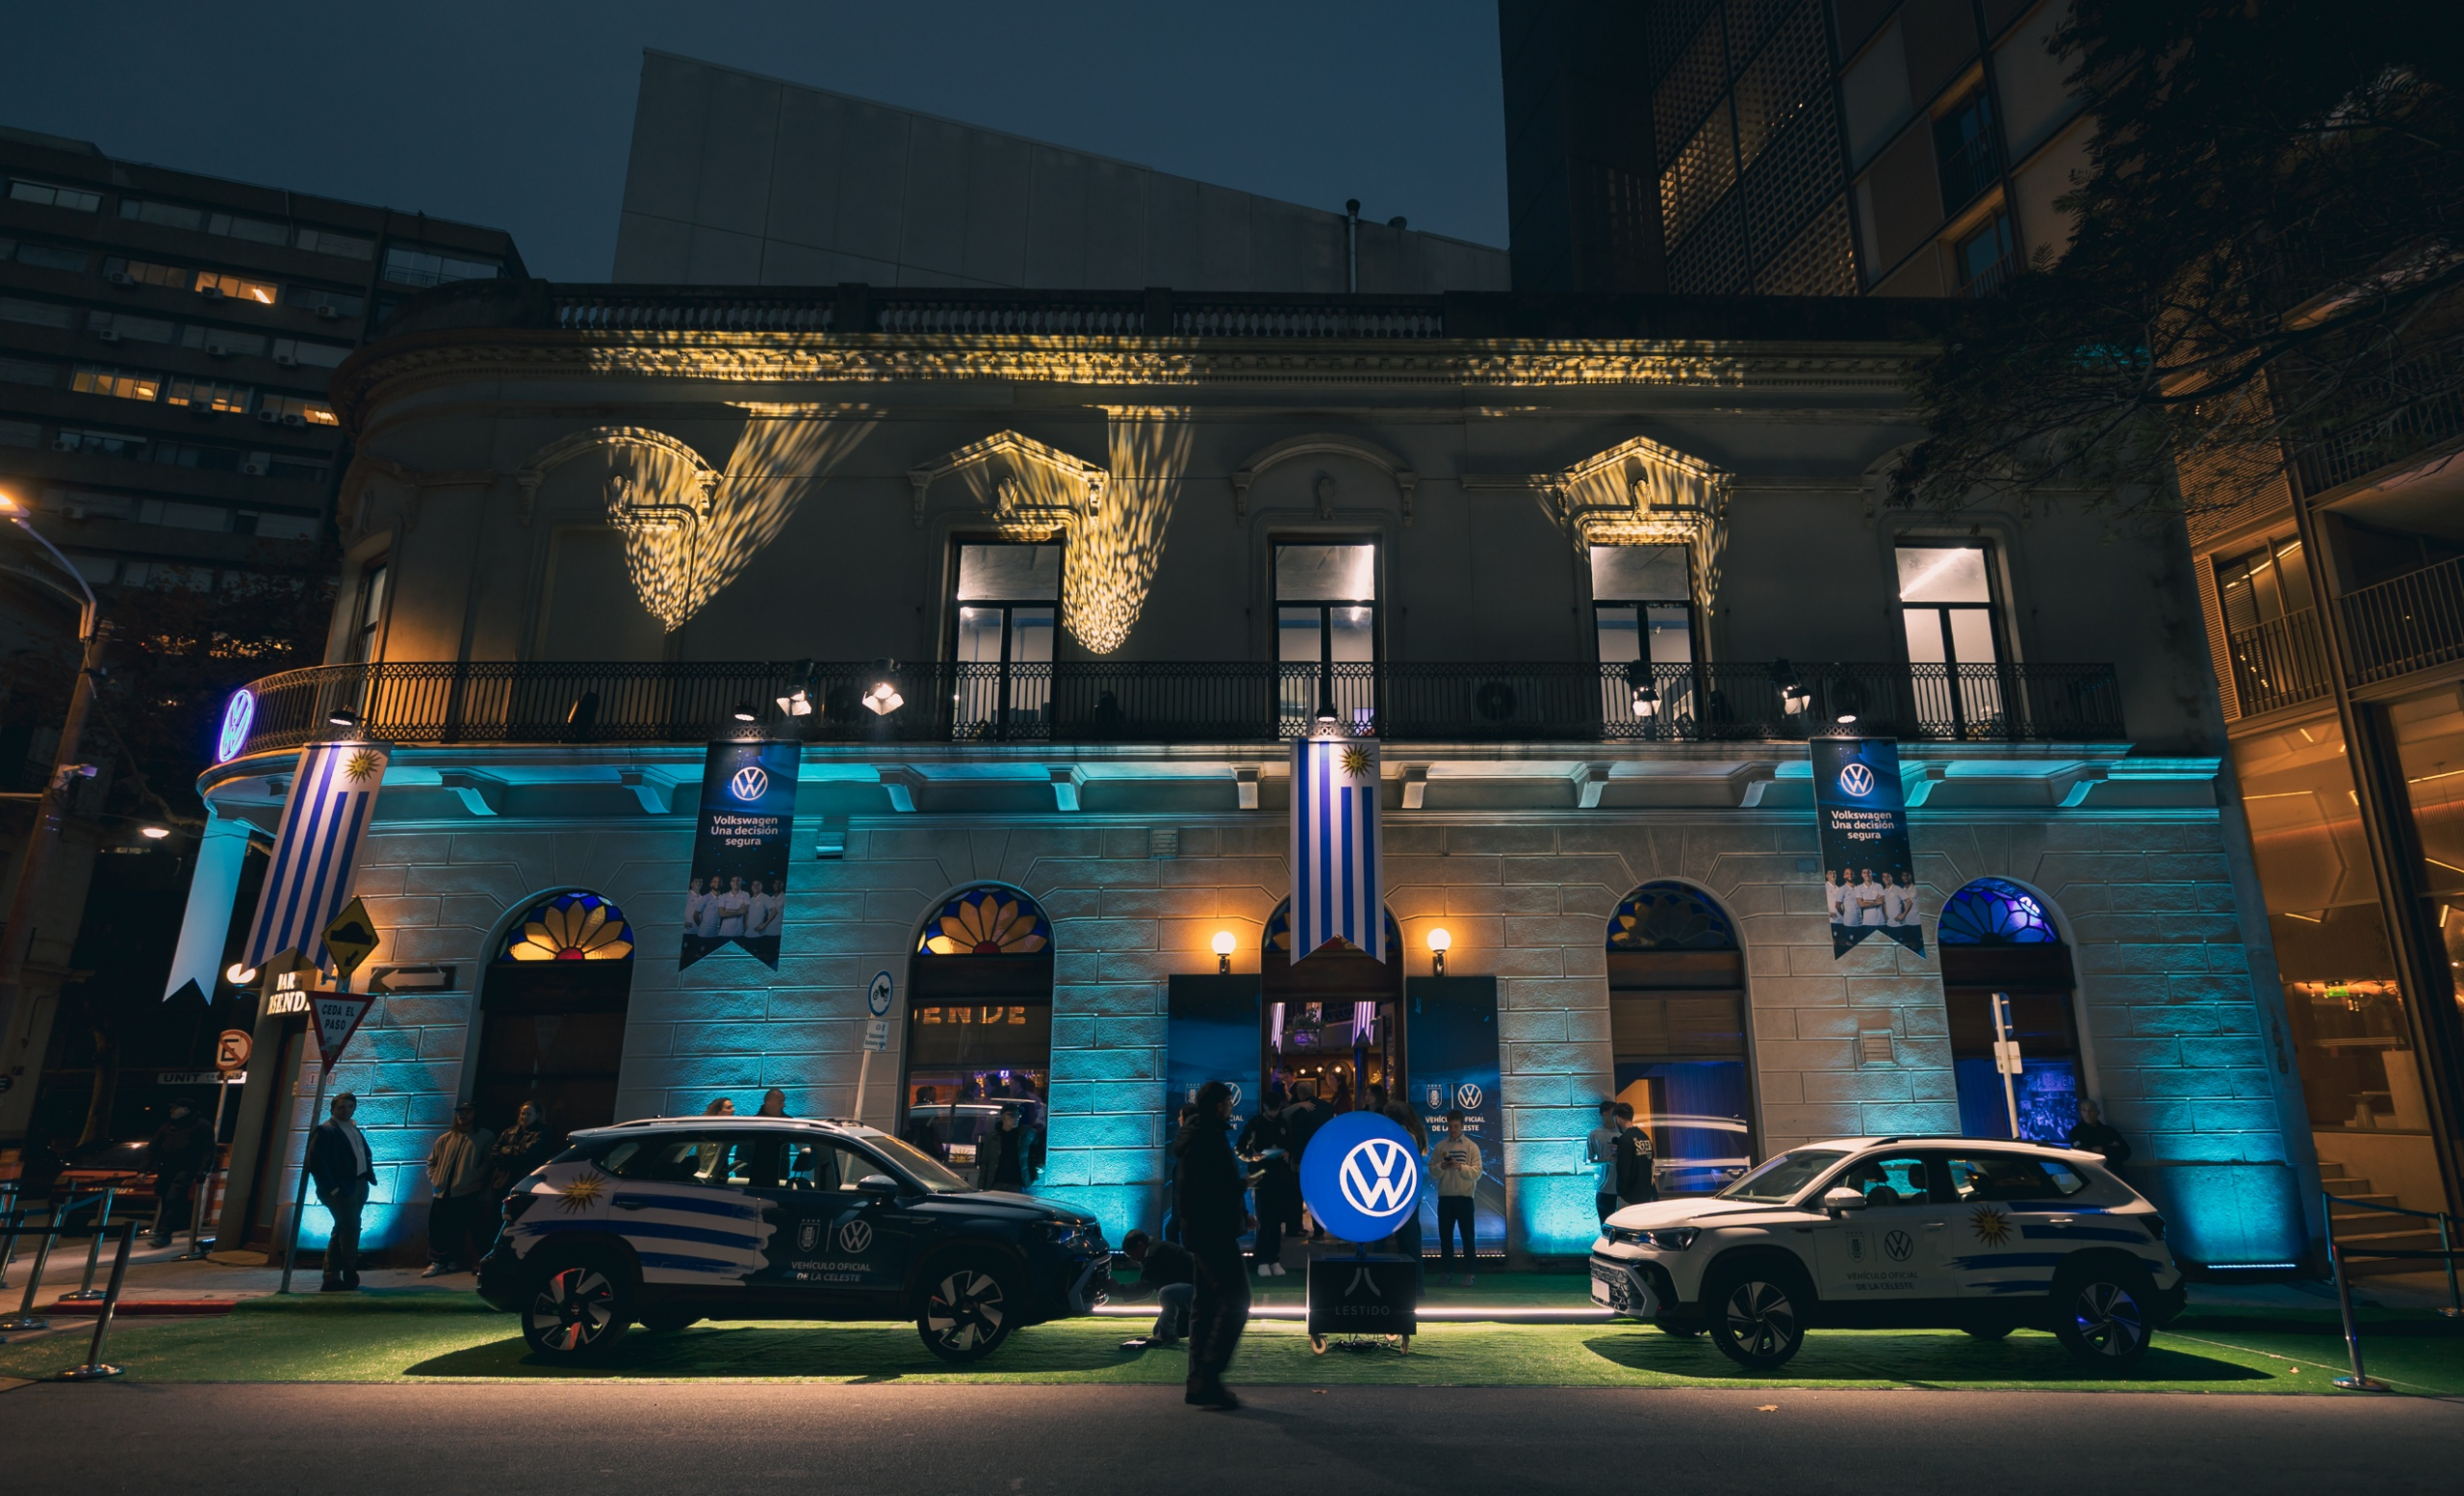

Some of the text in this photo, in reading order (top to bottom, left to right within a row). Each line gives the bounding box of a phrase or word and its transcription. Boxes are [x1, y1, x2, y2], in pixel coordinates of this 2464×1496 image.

[732, 766, 769, 801] VW
[1840, 762, 1874, 797] VW
[713, 815, 778, 827] Volkswagen
[1831, 811, 1892, 821] Volkswagen
[710, 825, 779, 835] Una decisión
[1831, 820, 1894, 830] Una decisión
[1847, 832, 1882, 841] segura
[725, 838, 761, 848] segura
[321, 1004, 354, 1017] CEDA EL
[324, 1019, 346, 1030] PASO
[164, 1073, 200, 1082] UNIT
[1457, 1083, 1482, 1109] VW
[1424, 1115, 1448, 1123] VEHÍC
[1339, 1138, 1417, 1217] VW
[840, 1220, 873, 1253] VW
[1884, 1229, 1913, 1262] VW
[791, 1260, 871, 1272] VEHÍCULO OFICIAL
[809, 1273, 822, 1281] LA
[823, 1273, 861, 1282] CELESTE
[1846, 1271, 1886, 1280] VEHÍCULO
[1335, 1304, 1390, 1316] LESTIDO
